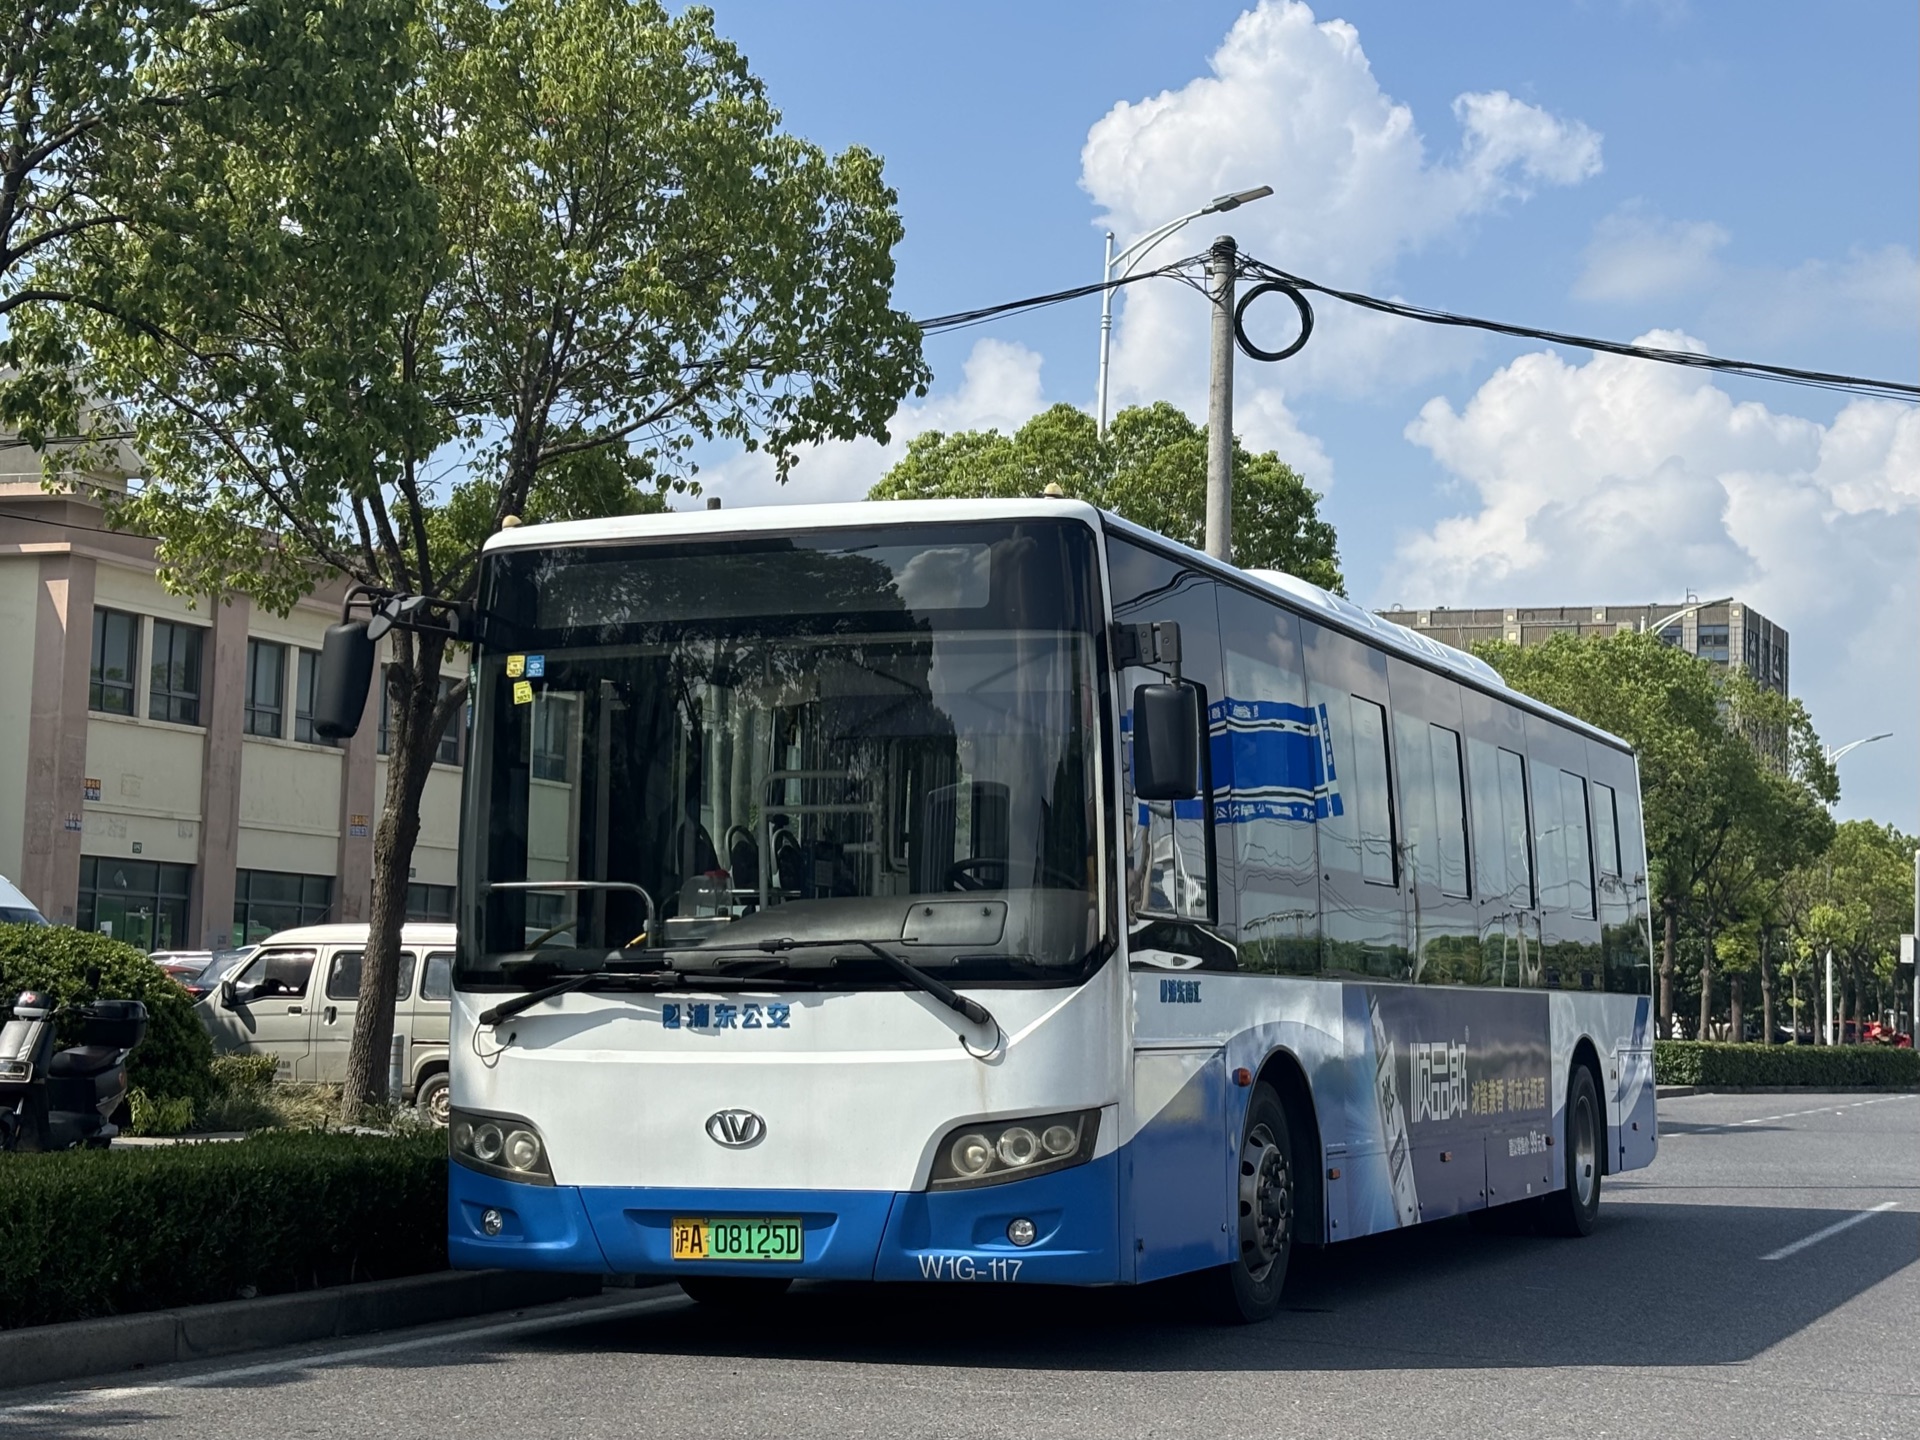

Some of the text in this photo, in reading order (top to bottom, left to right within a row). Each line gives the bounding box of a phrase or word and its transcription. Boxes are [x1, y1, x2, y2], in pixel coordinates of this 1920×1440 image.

[685, 1003, 791, 1030] 浦东公交
[1410, 1038, 1468, 1124] 顺品郎
[918, 1254, 1023, 1281] W1G-117
